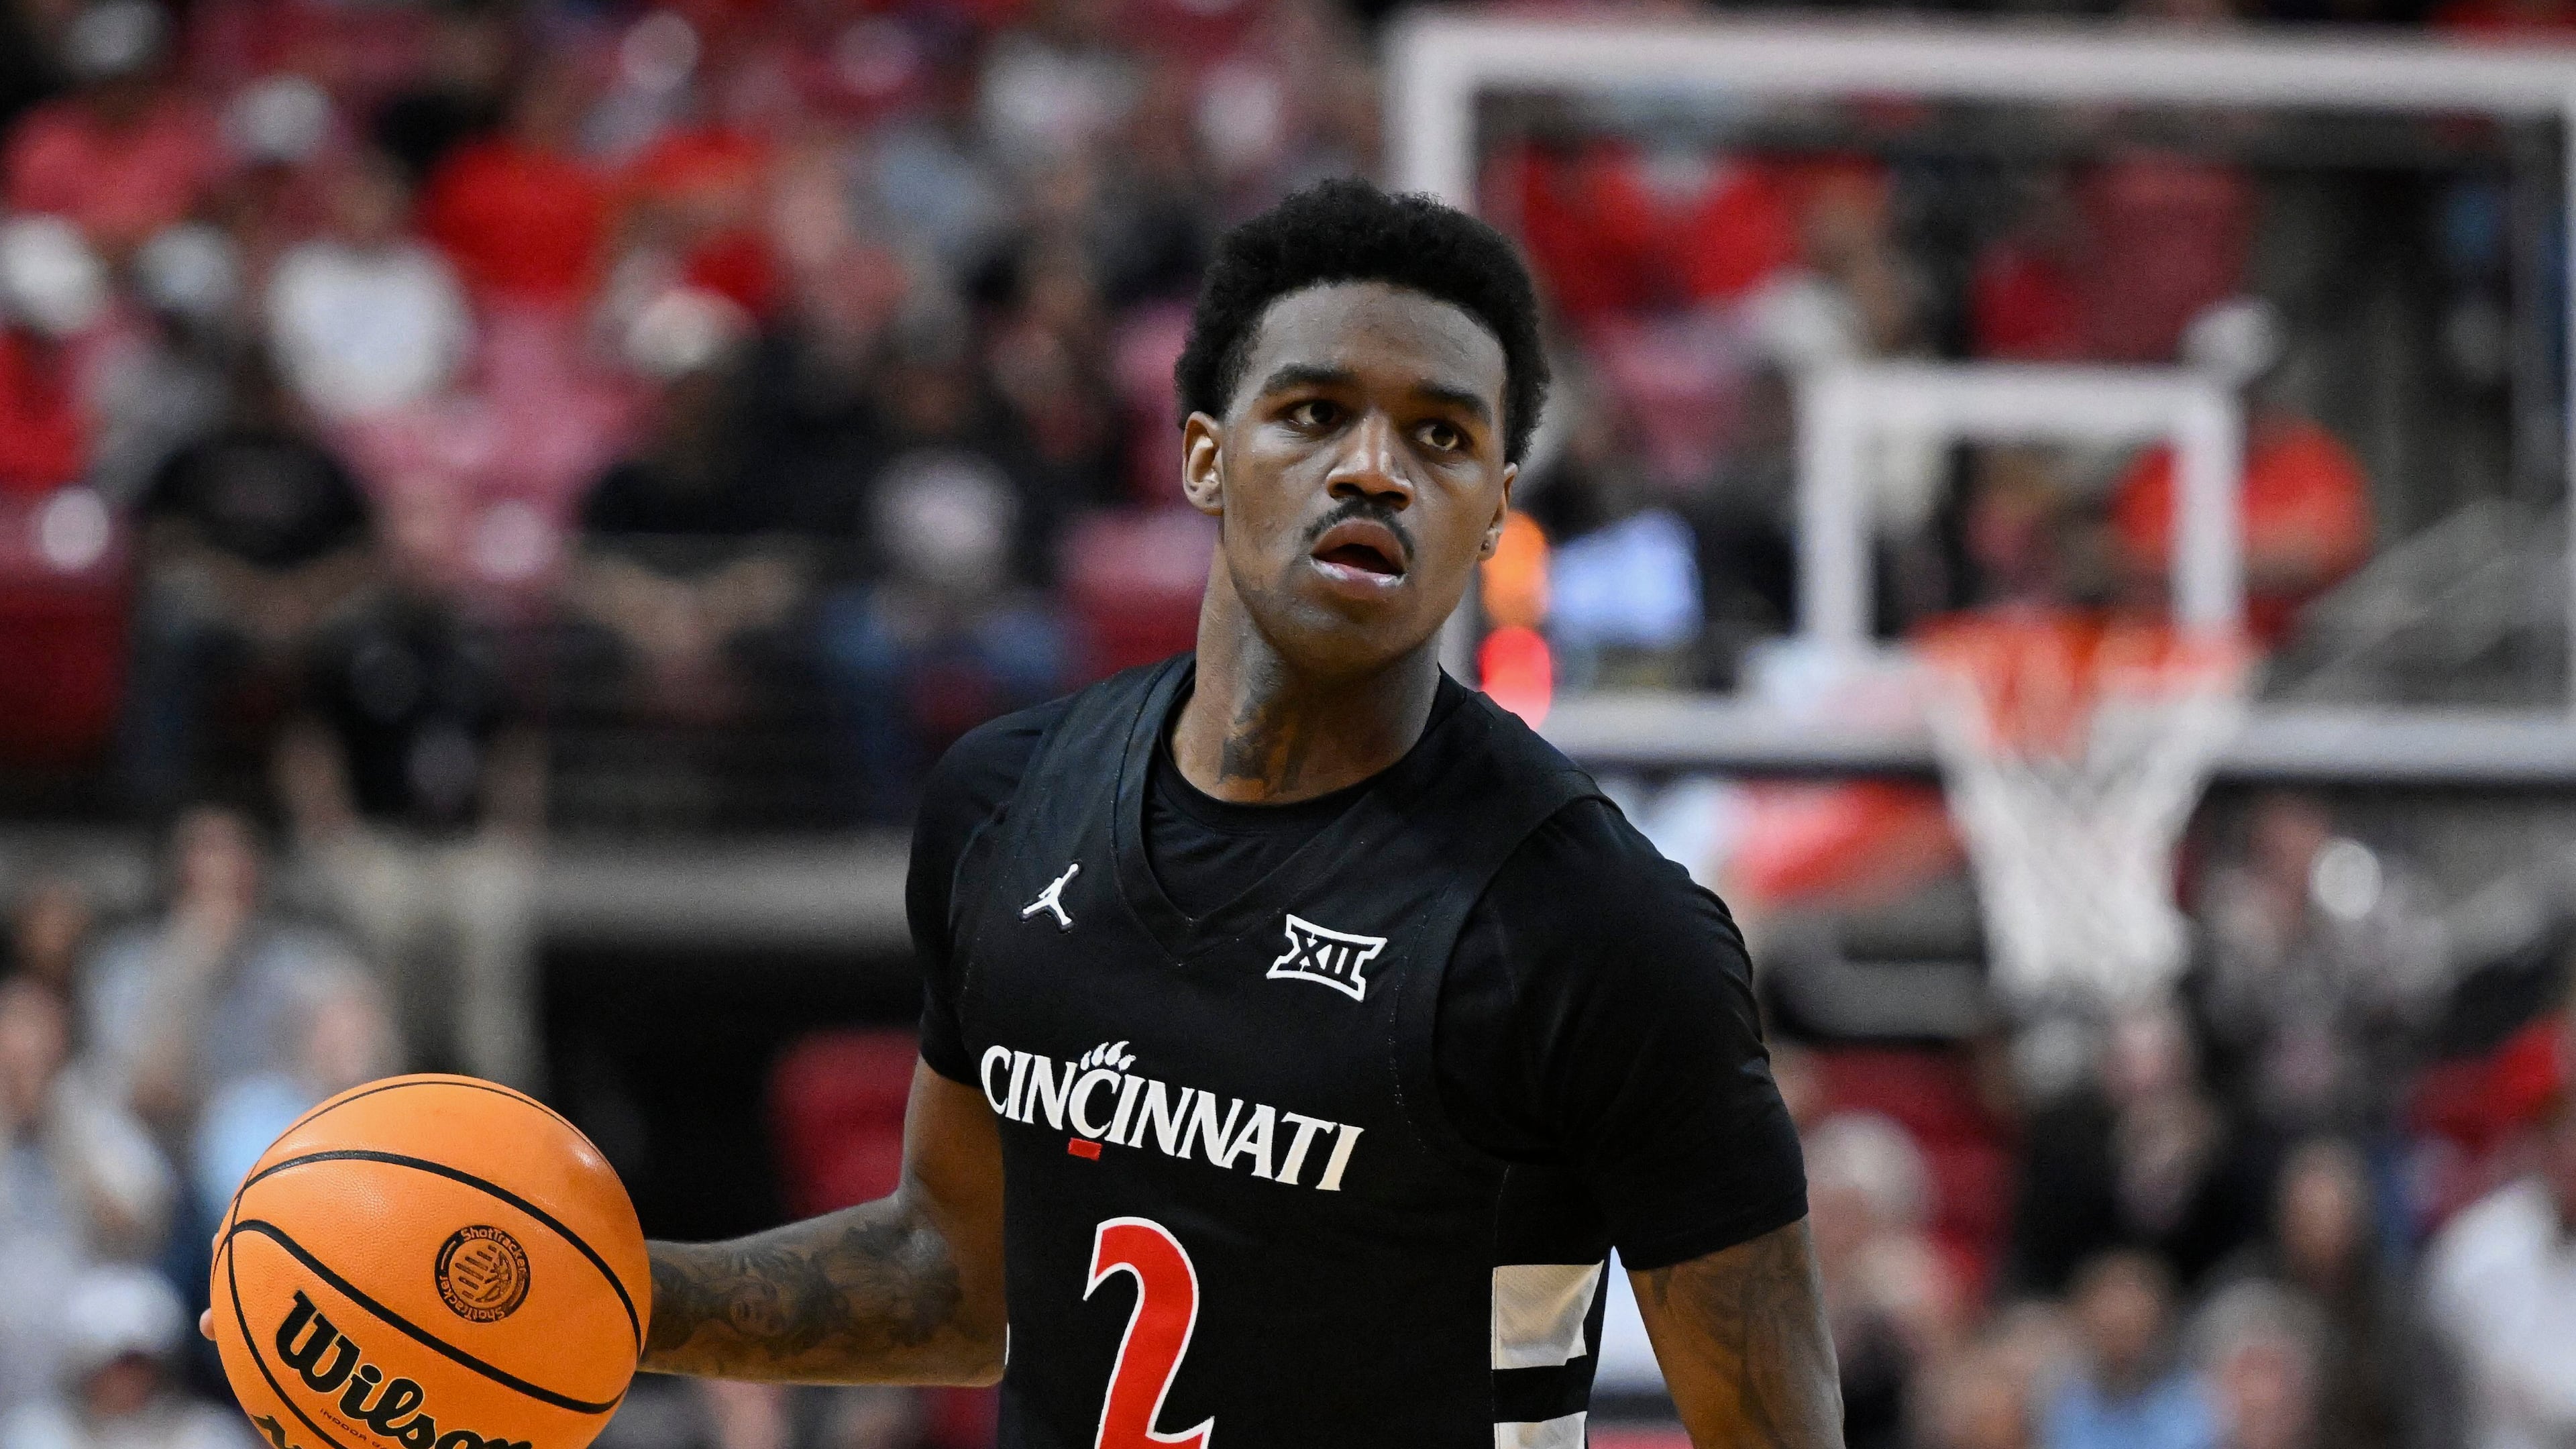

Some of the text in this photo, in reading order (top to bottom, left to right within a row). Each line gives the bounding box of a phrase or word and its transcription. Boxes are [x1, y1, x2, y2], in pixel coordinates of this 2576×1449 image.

[1273, 920, 1379, 996] XII
[980, 1044, 1364, 1191] CINCINNATI
[461, 1227, 527, 1273] ShotTracker
[439, 1275, 505, 1322] ShotTracker
[1083, 1216, 1215, 1449] 2
[320, 1408, 367, 1441] INDOOR
